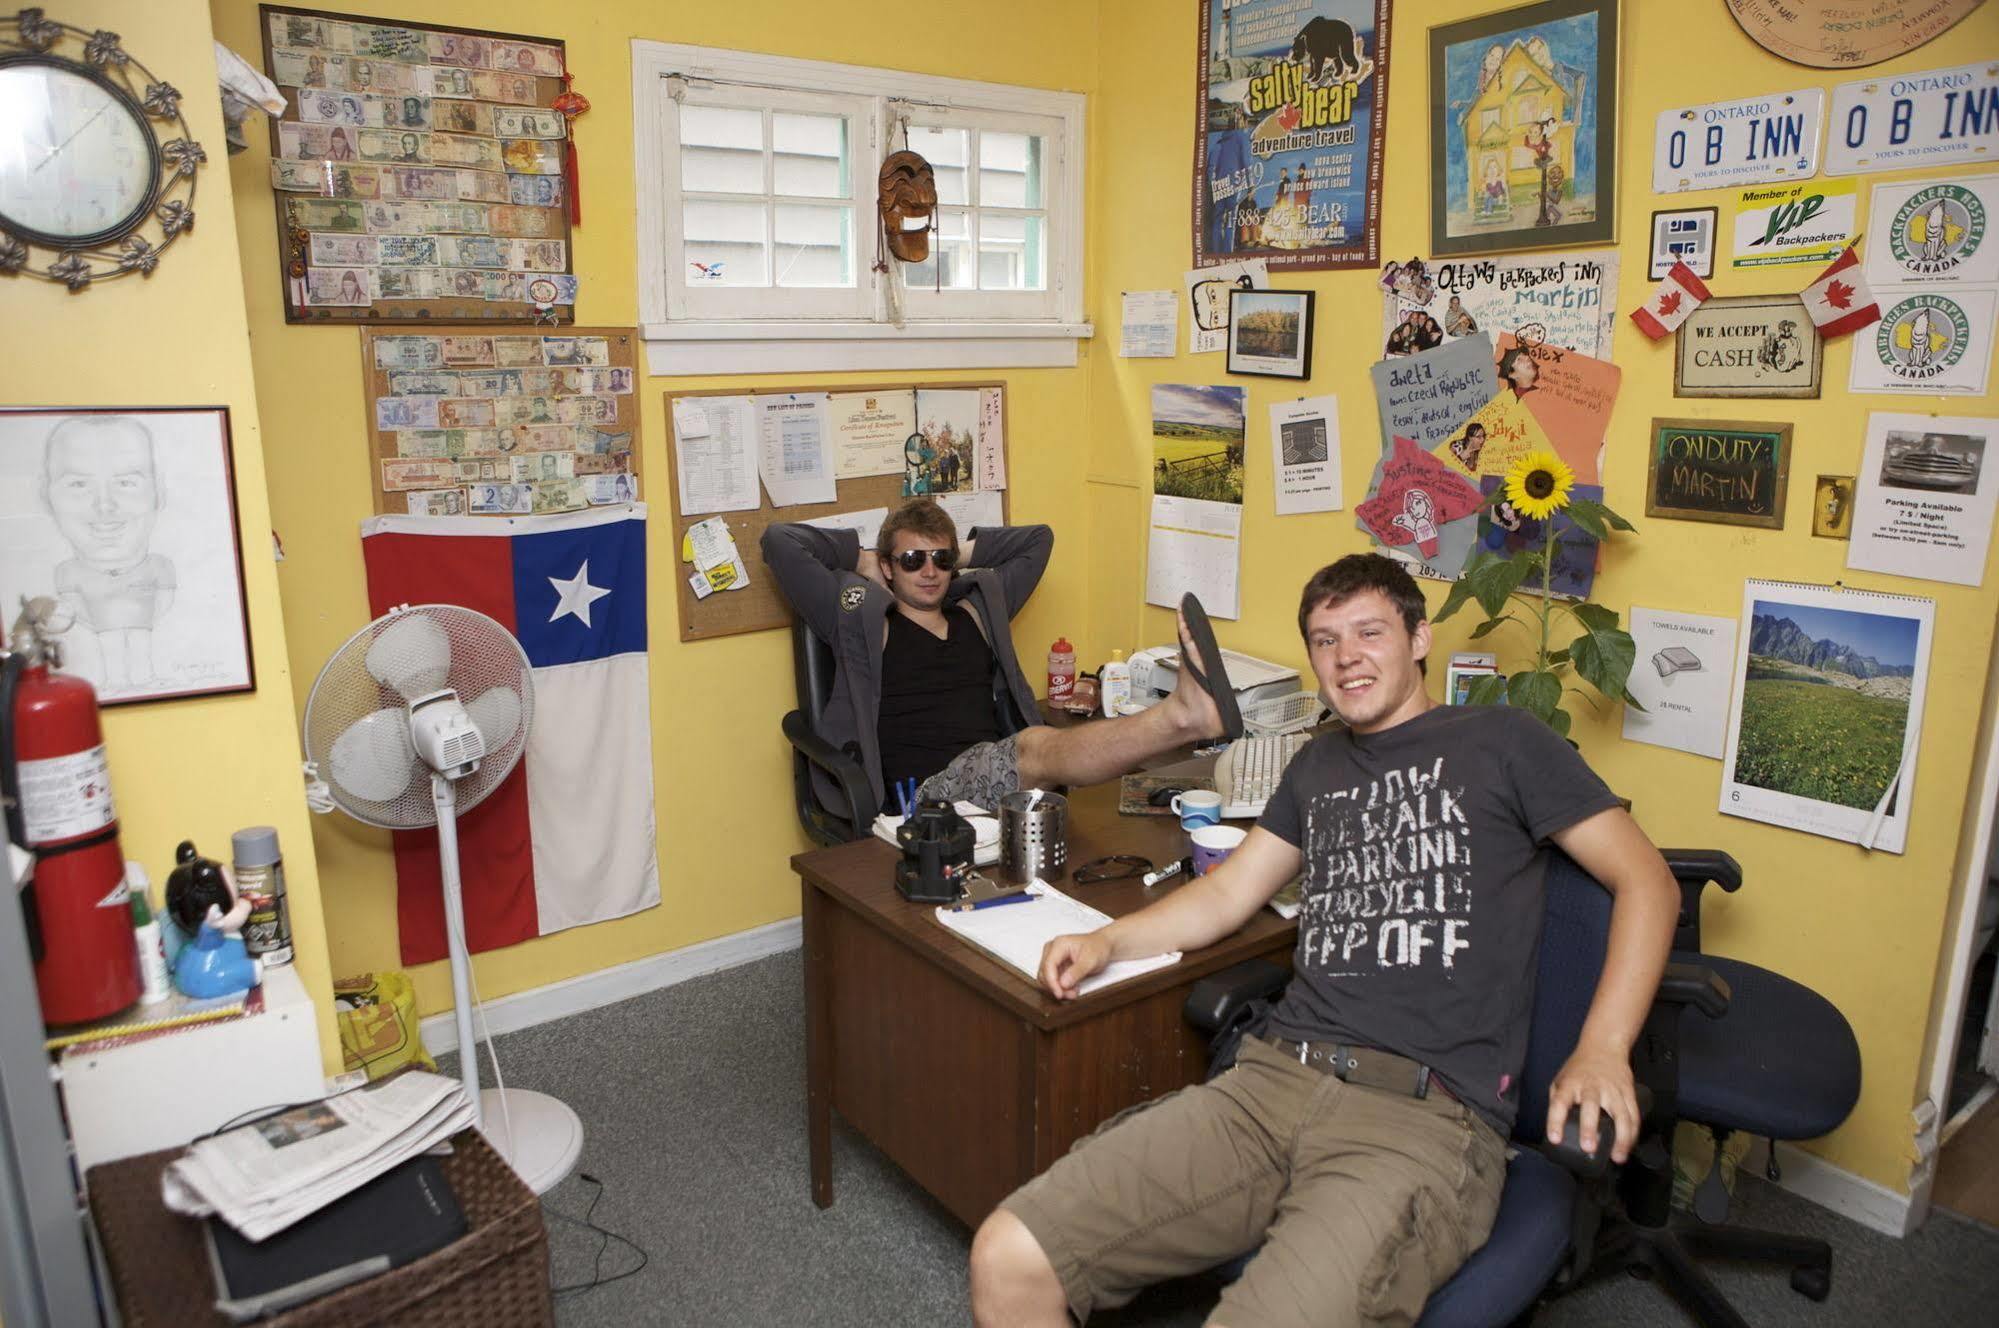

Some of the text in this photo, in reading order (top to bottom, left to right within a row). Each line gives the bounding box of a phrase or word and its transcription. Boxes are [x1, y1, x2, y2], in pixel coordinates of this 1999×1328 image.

[1890, 73, 1973, 98] ONTARIO
[1250, 61, 1359, 129] salty bear
[1704, 103, 1771, 124] ONTARIO
[1889, 98, 1913, 145] B
[1252, 126, 1355, 154] adventure travel
[1705, 124, 1723, 166] B
[1746, 113, 1804, 161] INN
[1331, 153, 1353, 165] scotia
[1874, 142, 1969, 160] YOURS TO DISCOVER
[1318, 164, 1352, 176] brunswick
[1694, 163, 1771, 180] YOURS TO DISCOVER
[1331, 177, 1351, 188] island
[1742, 186, 1803, 202] Member of
[1890, 185, 1985, 257] BACKPACKERS HOSTELS
[1775, 233, 1846, 246] Backpackers
[1905, 256, 1961, 274] CANADA
[1437, 261, 1495, 294] Ottawa
[1513, 284, 1599, 309] Martin
[1695, 323, 1769, 339] WE ACCEPT
[1694, 349, 1754, 367] CASH
[1892, 364, 1945, 379] CANADA
[1671, 468, 1760, 502] MARTIN
[1885, 499, 1963, 513] Parking Available
[1920, 512, 1945, 521] Night
[1652, 621, 1715, 636] TOWELS AVAILABLE
[1667, 702, 1693, 713] RENTAL
[1731, 790, 1741, 802] 6
[1377, 918, 1470, 967] OFF
